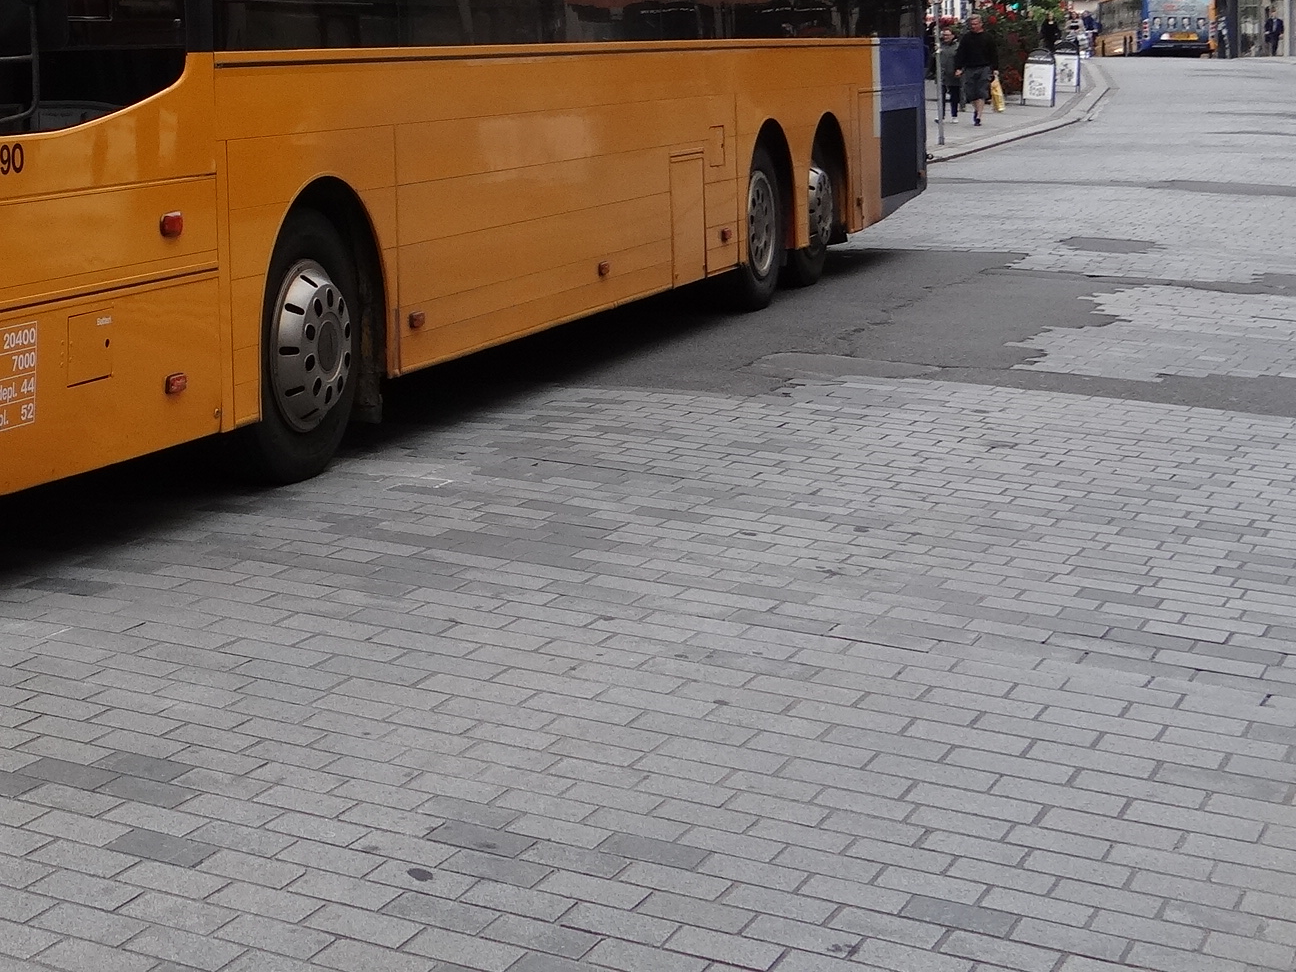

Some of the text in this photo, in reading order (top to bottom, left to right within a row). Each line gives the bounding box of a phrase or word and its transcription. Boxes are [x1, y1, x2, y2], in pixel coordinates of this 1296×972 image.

[3, 327, 36, 350] 20400
[11, 351, 36, 372] 7000
[20, 377, 35, 395] 44
[20, 402, 34, 421] 52
